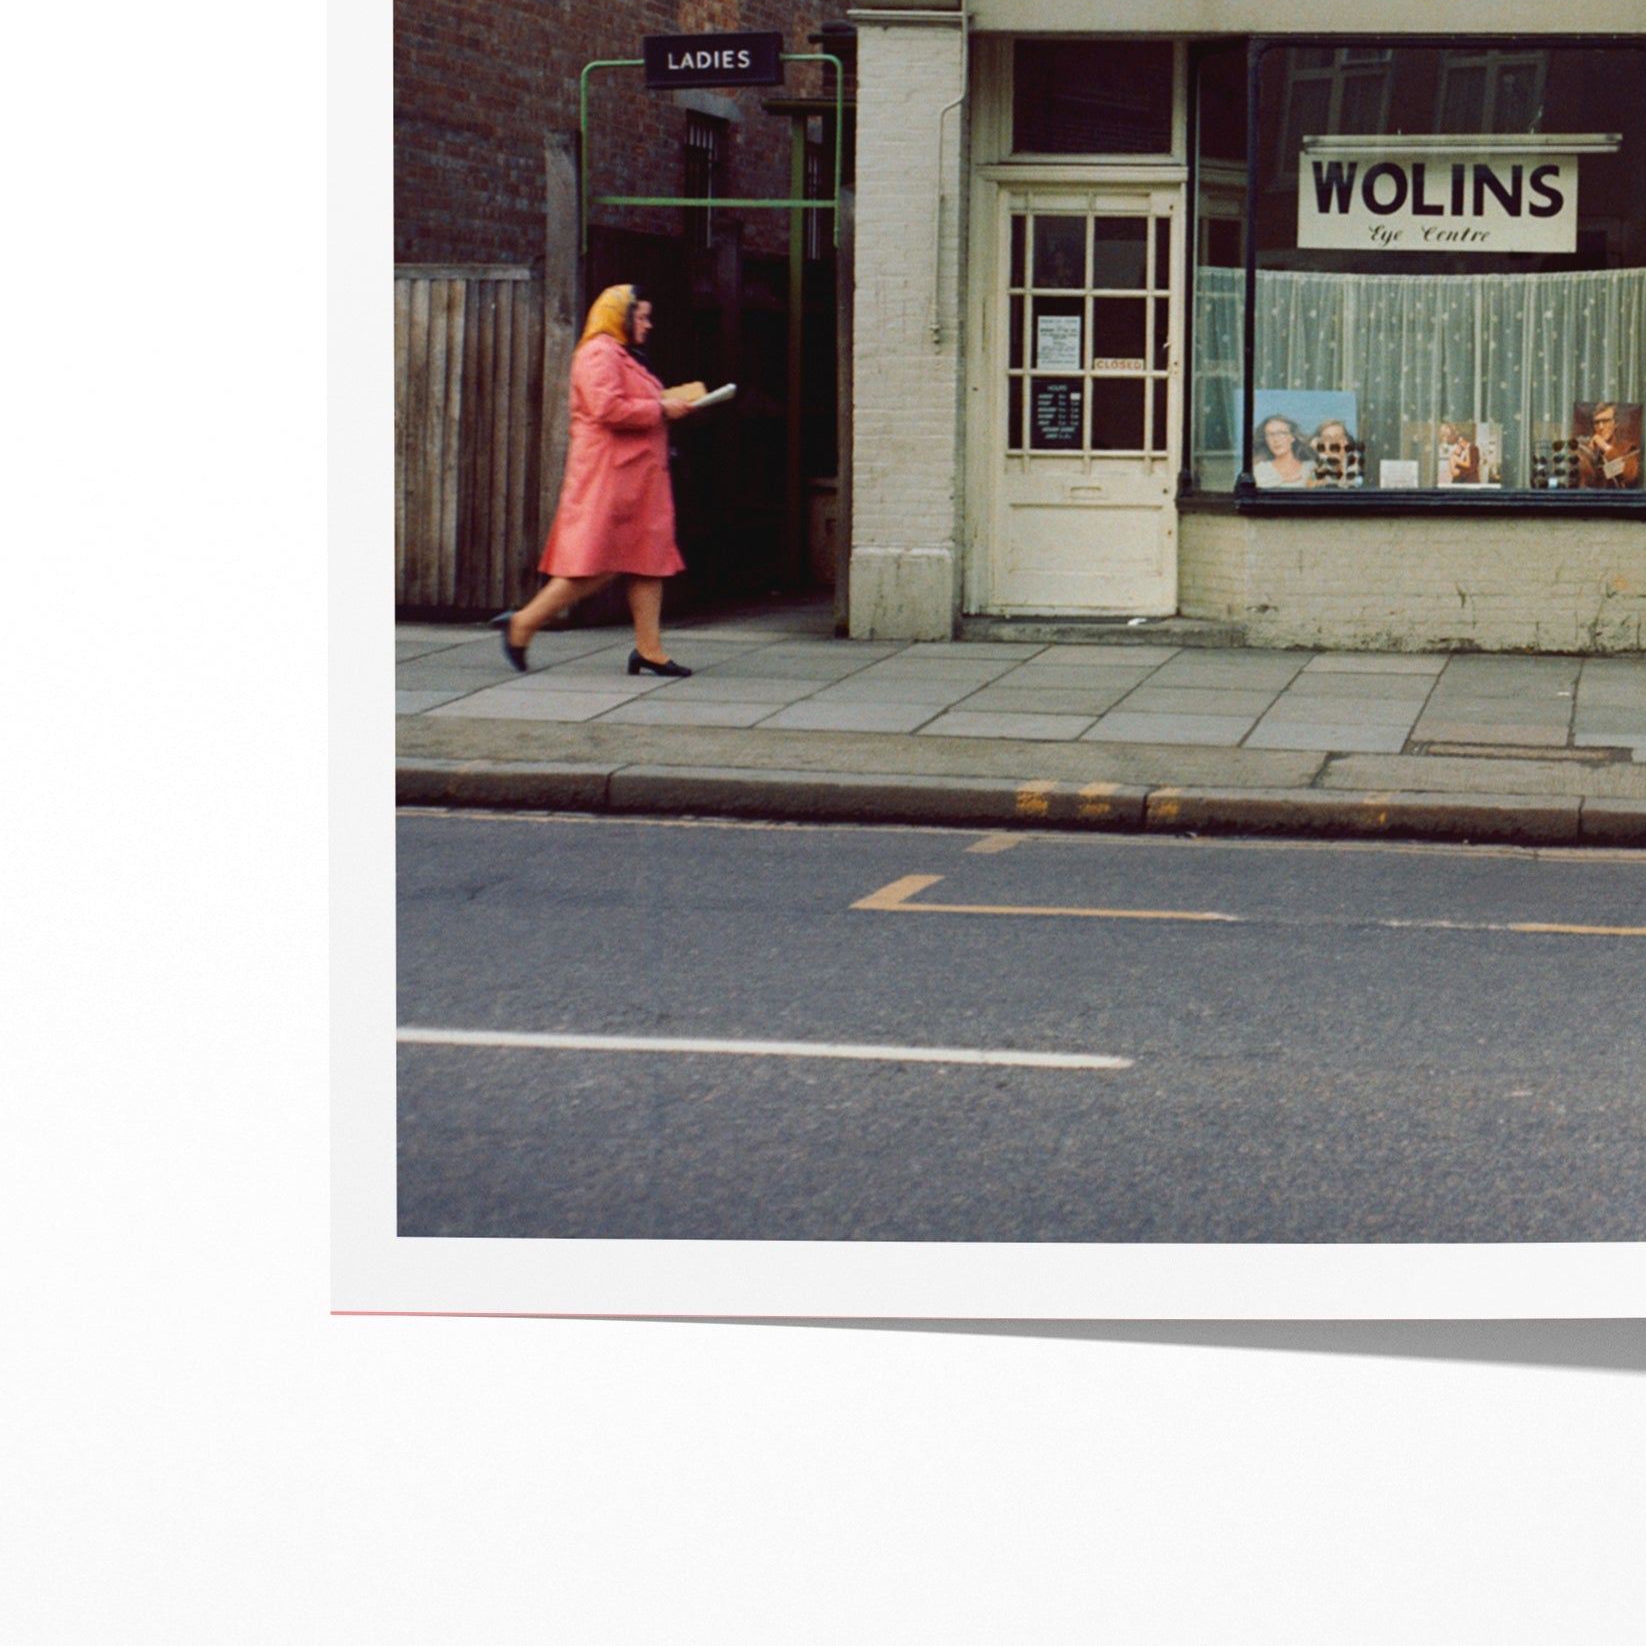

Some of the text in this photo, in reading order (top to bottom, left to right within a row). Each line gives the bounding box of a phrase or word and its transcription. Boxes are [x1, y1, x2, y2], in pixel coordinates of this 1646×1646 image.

[668, 50, 750, 69] LADIES
[1312, 161, 1564, 218] WOLINS
[1369, 225, 1490, 247] Eye Centre
[1096, 360, 1142, 370] CLOSED
